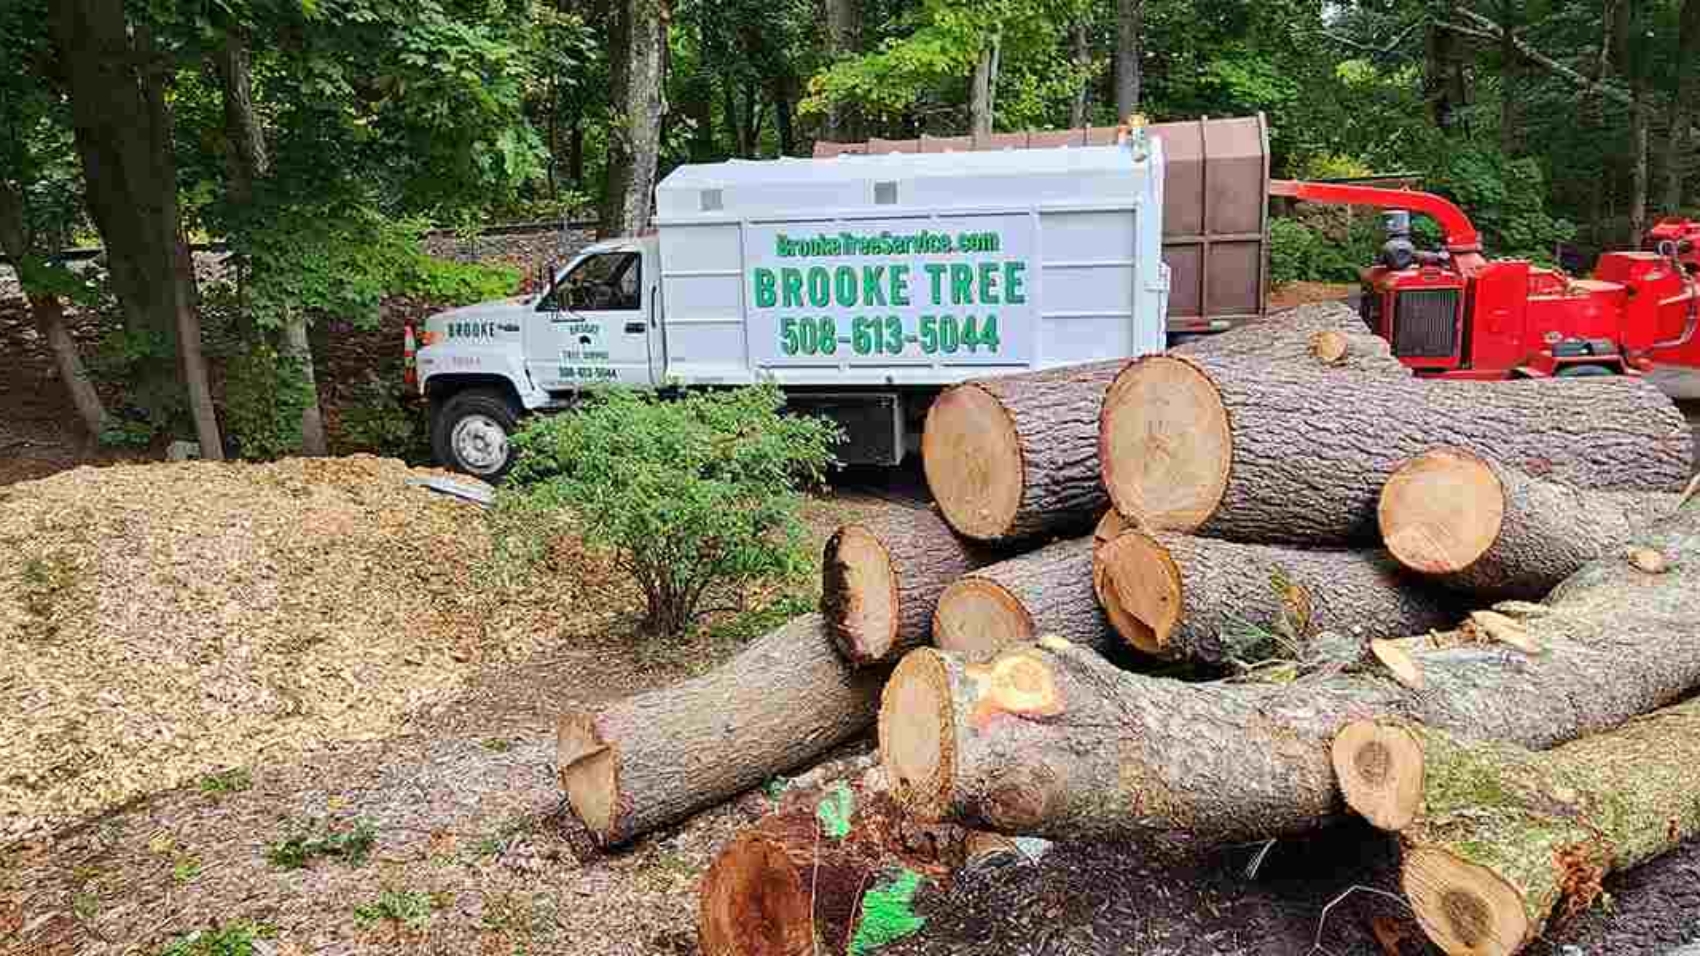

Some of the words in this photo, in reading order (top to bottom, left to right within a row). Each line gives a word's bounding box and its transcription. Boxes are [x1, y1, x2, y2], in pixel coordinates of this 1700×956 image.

[754, 267, 910, 308] BROOKE
[925, 261, 1026, 305] TREE
[447, 321, 495, 338] BROOKE
[780, 314, 1000, 356] 508-613-5044
